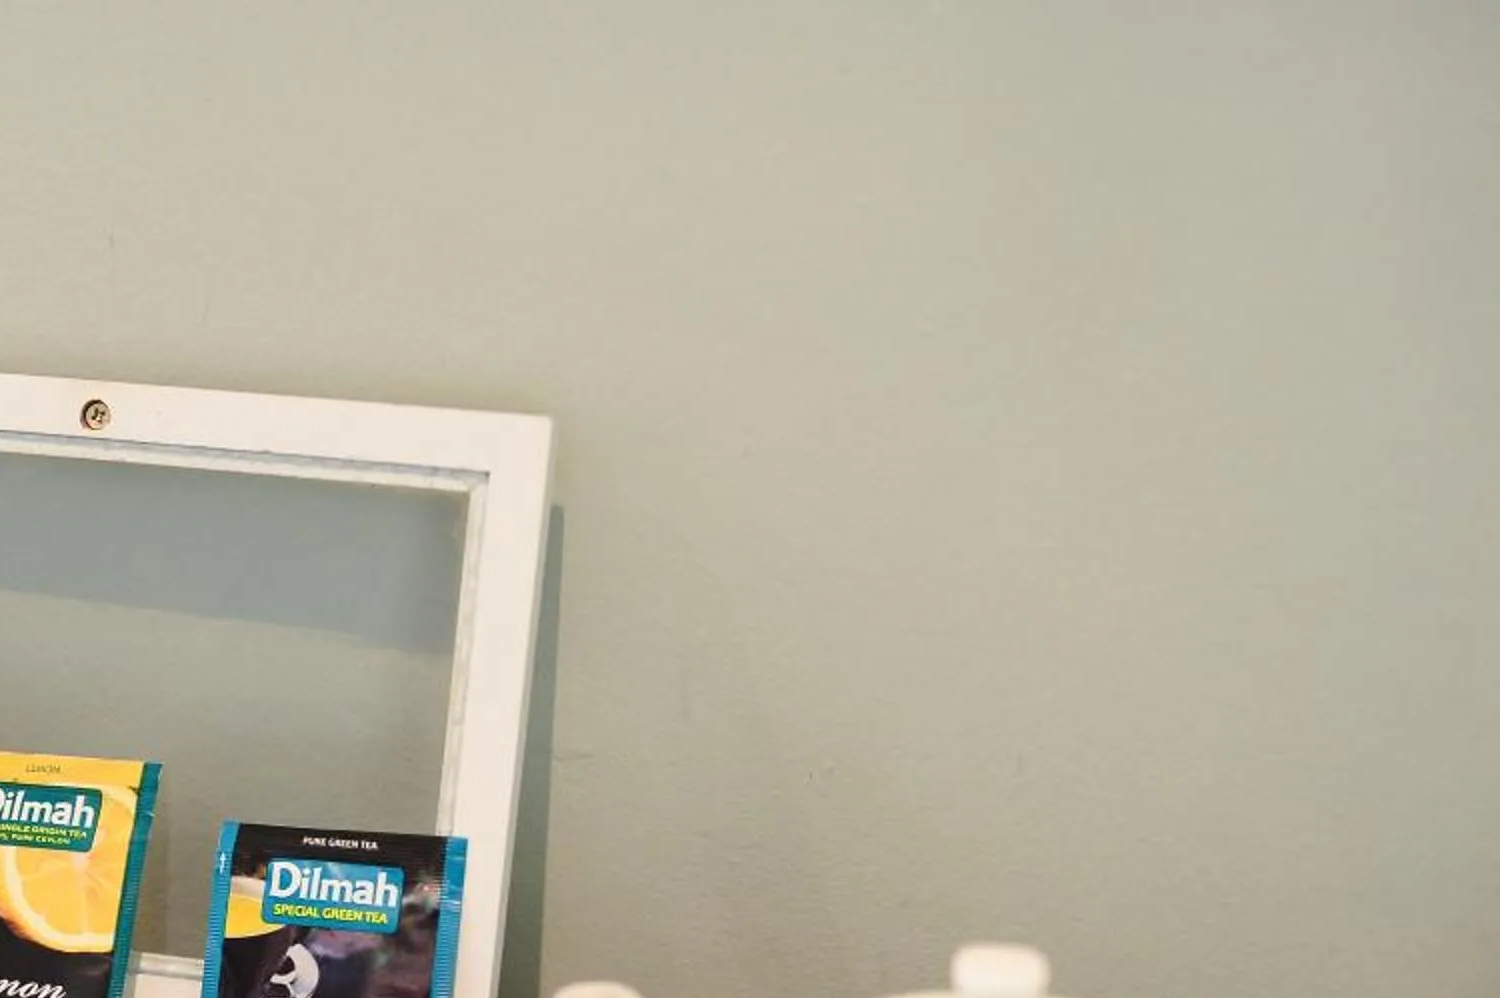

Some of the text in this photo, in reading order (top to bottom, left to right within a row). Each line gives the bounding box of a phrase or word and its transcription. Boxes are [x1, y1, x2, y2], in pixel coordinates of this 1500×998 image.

[31, 827, 66, 837] ORIGIN
[68, 830, 87, 840] TEA
[303, 836, 379, 850] PURE GREEN TEA
[269, 861, 399, 908] Dilmah
[274, 903, 388, 924] SPECIAL GREEN TEA
